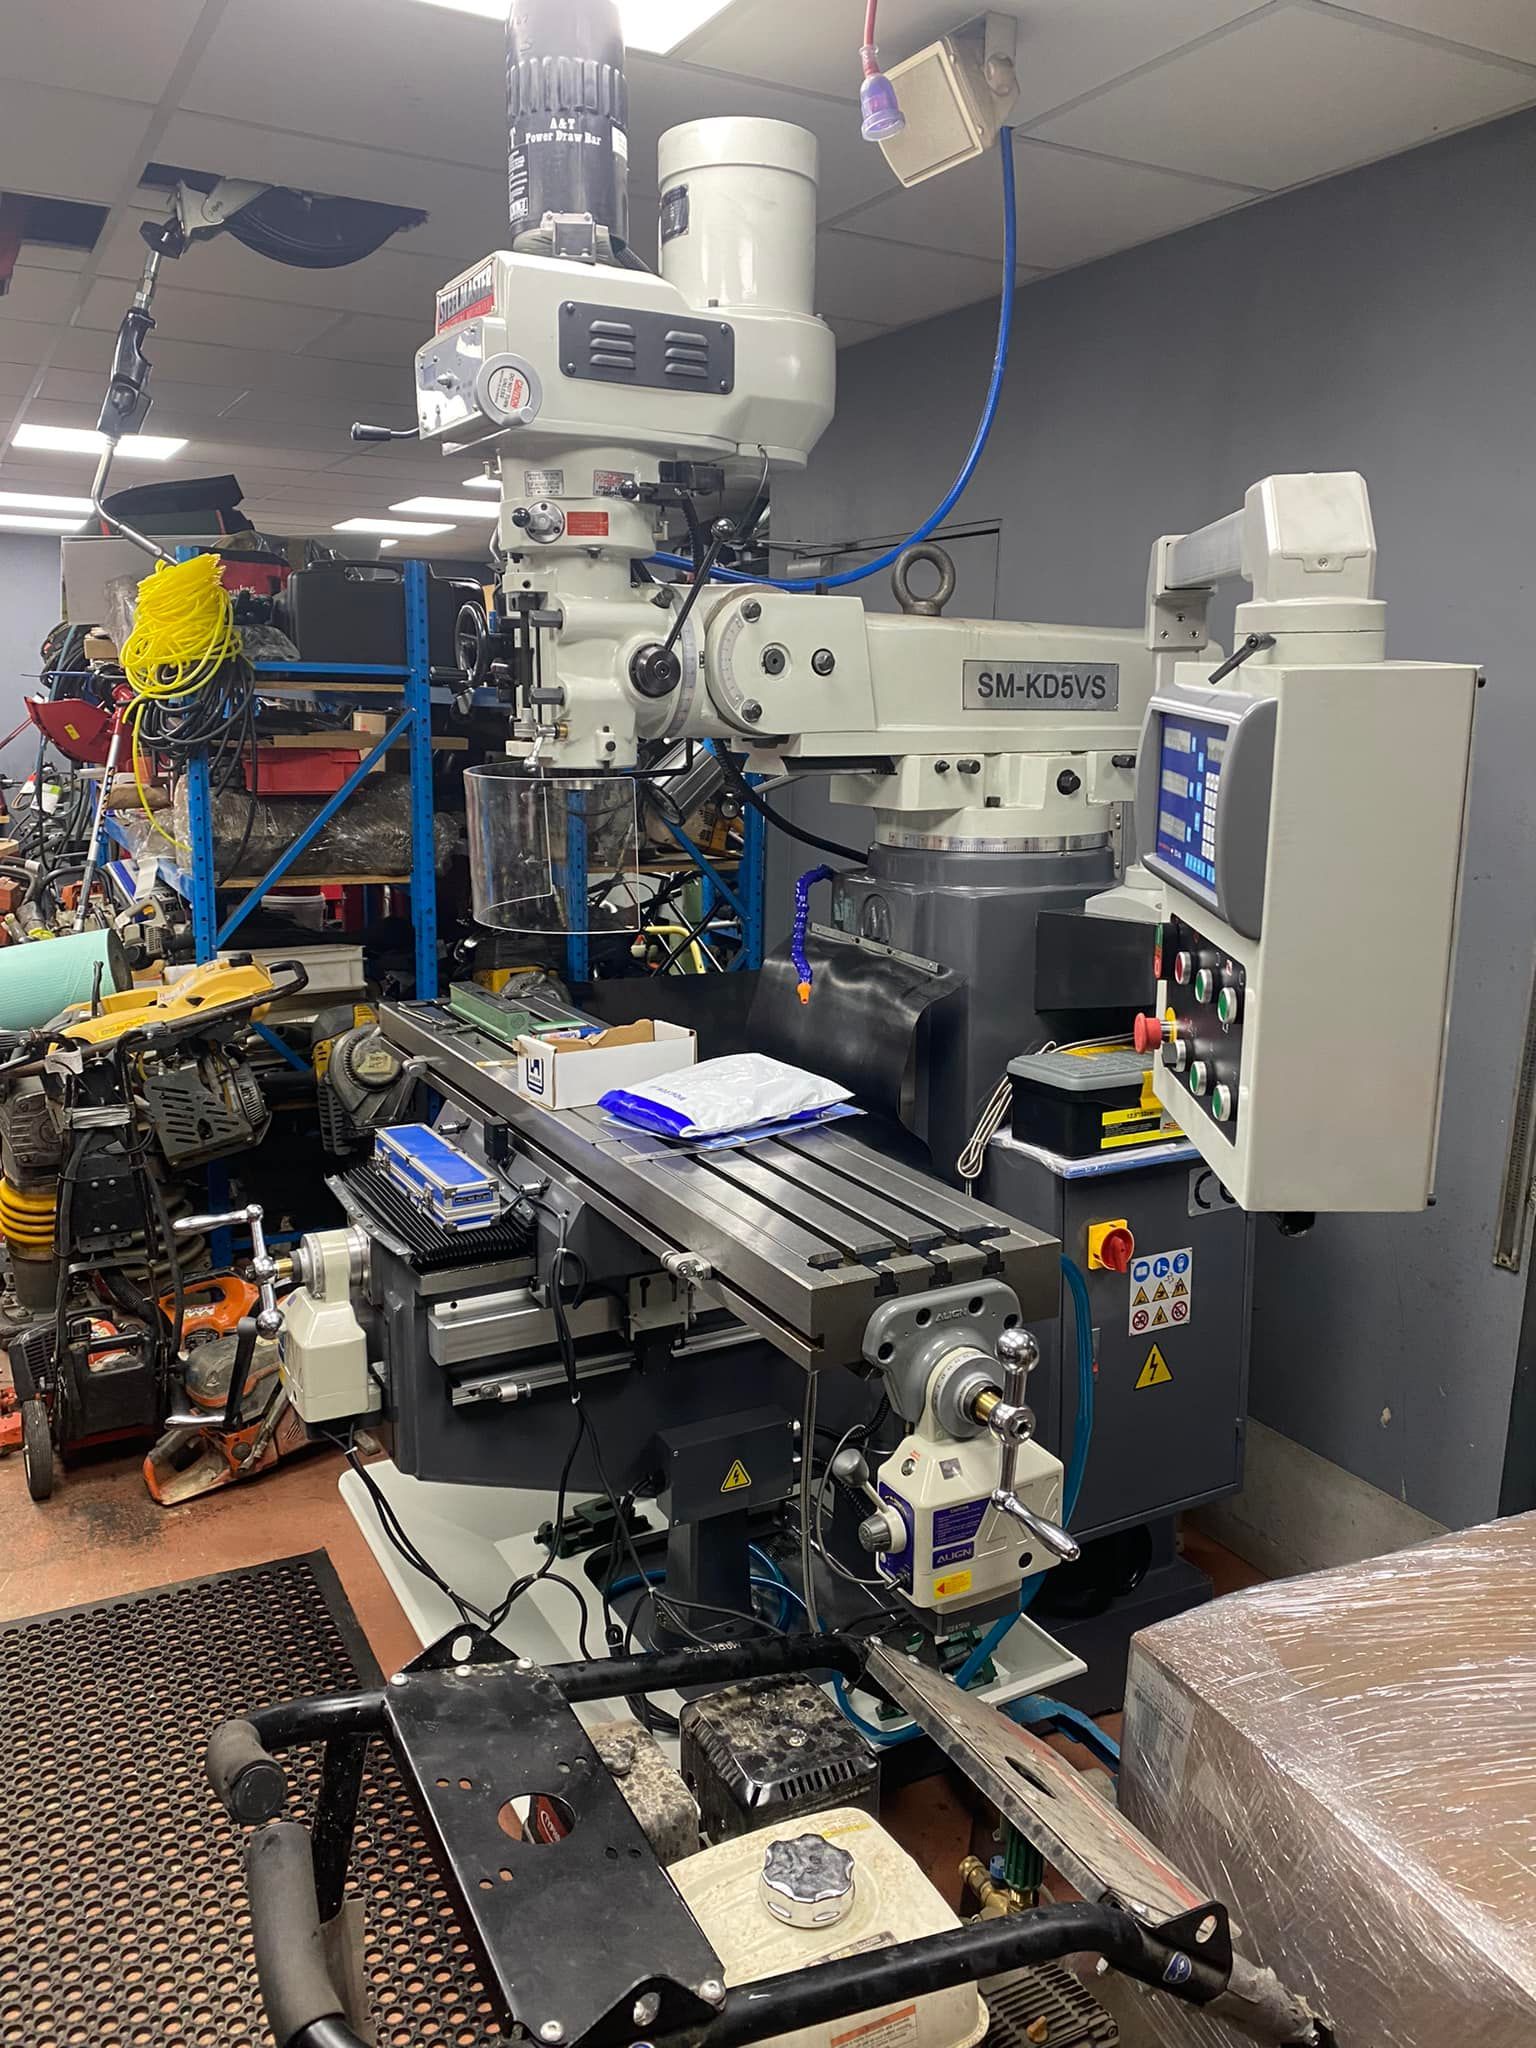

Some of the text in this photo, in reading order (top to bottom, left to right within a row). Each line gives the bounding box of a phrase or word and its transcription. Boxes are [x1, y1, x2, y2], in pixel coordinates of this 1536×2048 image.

[525, 132, 554, 145] Power
[555, 130, 582, 142] Draw
[584, 131, 602, 145] Bar
[977, 672, 1106, 699] SM-KD5VS
[937, 1547, 972, 1564] ALIGN
